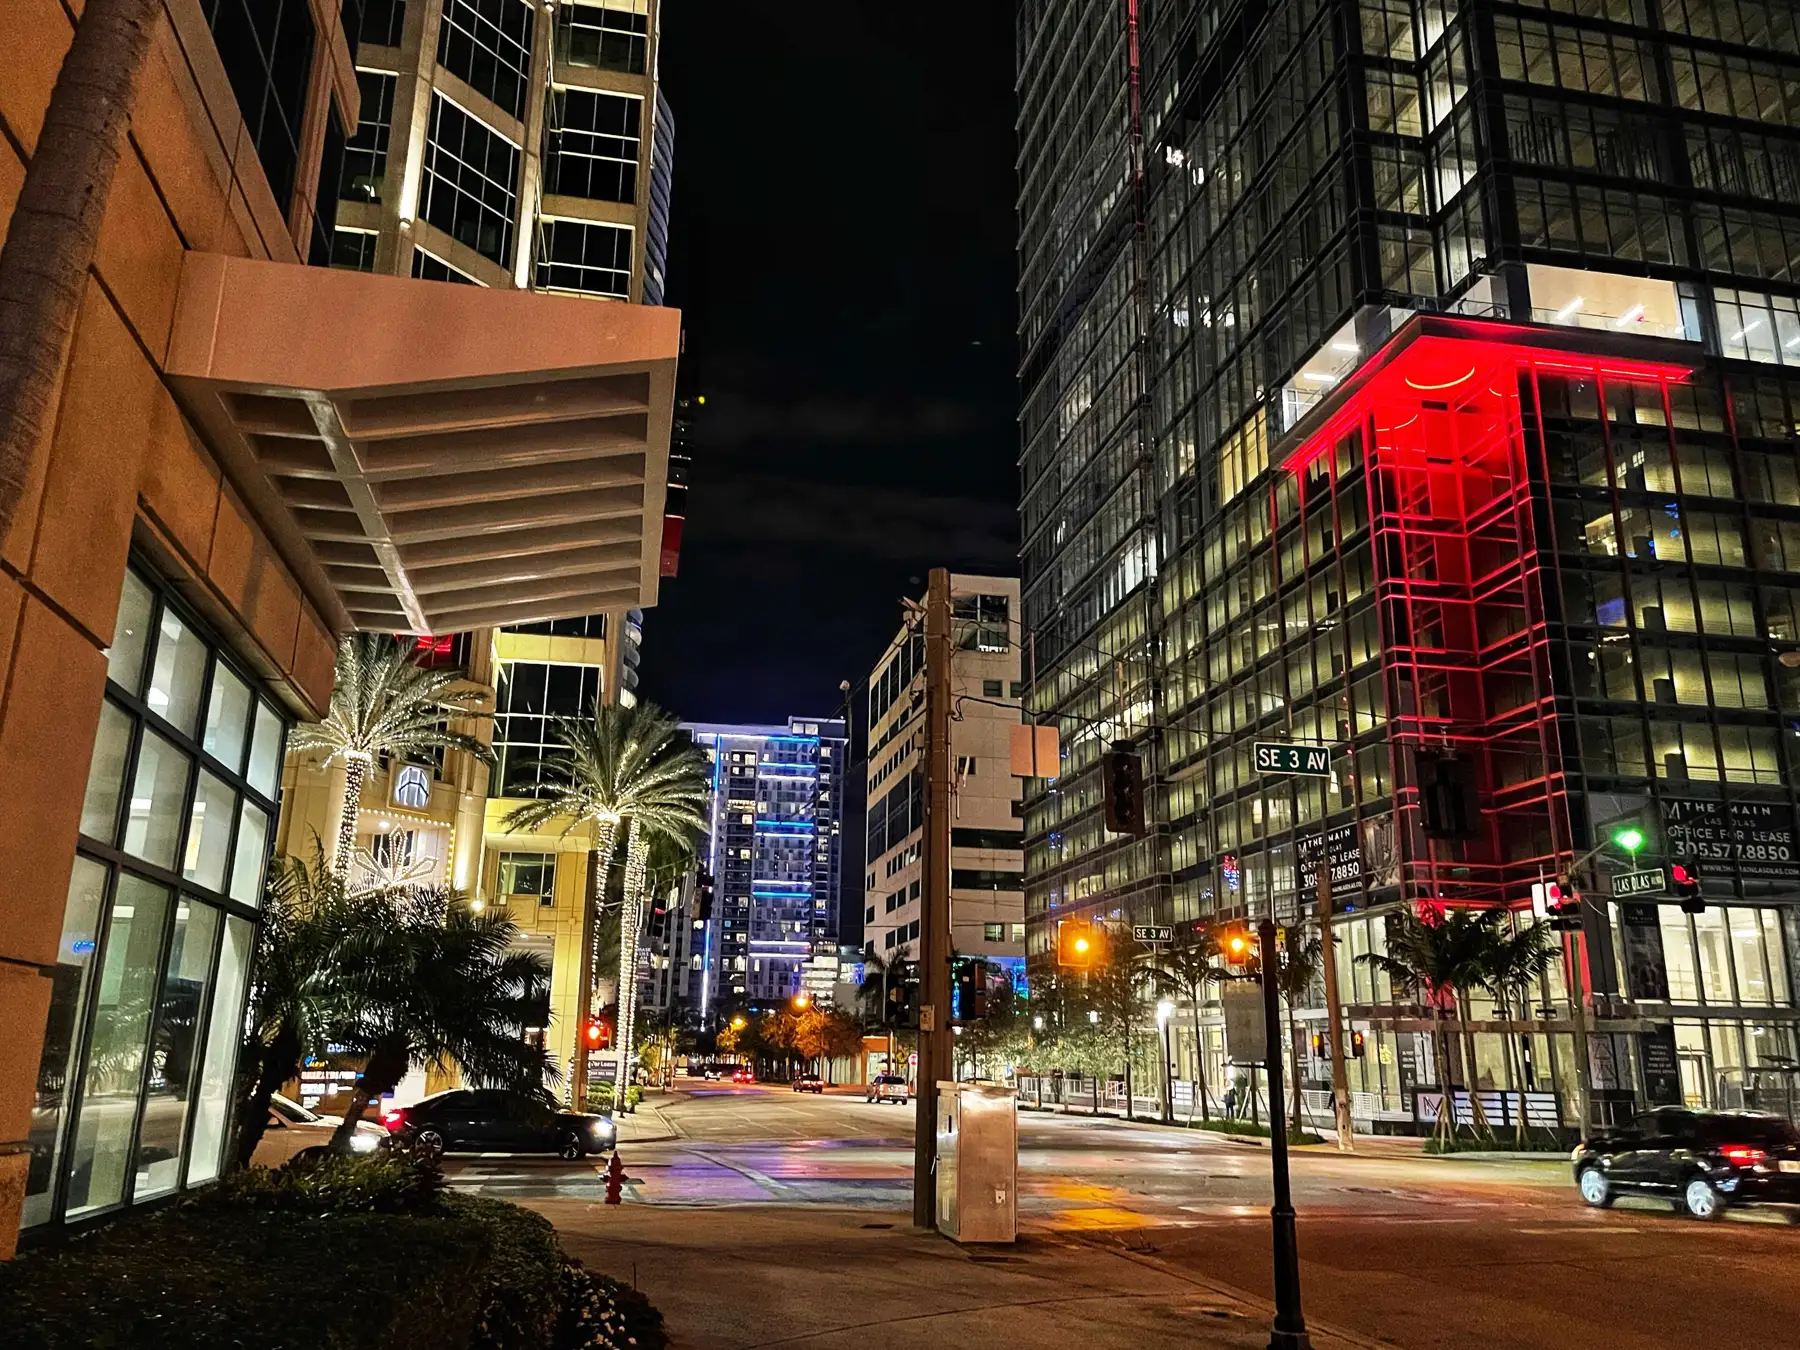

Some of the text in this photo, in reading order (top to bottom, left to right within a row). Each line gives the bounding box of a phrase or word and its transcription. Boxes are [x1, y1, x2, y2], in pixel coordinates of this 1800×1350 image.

[1259, 748, 1325, 770] SE 3 AV
[1683, 802, 1771, 816] THE MAIN
[1704, 818, 1722, 826] LAS
[1308, 828, 1351, 848] THE MAIN
[1668, 827, 1714, 839] OFFICE
[1752, 831, 1791, 843] LEASE
[1340, 848, 1361, 863] LEASE
[1675, 841, 1790, 860] 305.577.8850
[1617, 878, 1630, 892] LAS
[1631, 875, 1650, 890] OLAS
[1136, 928, 1169, 939] SE 3 AV
